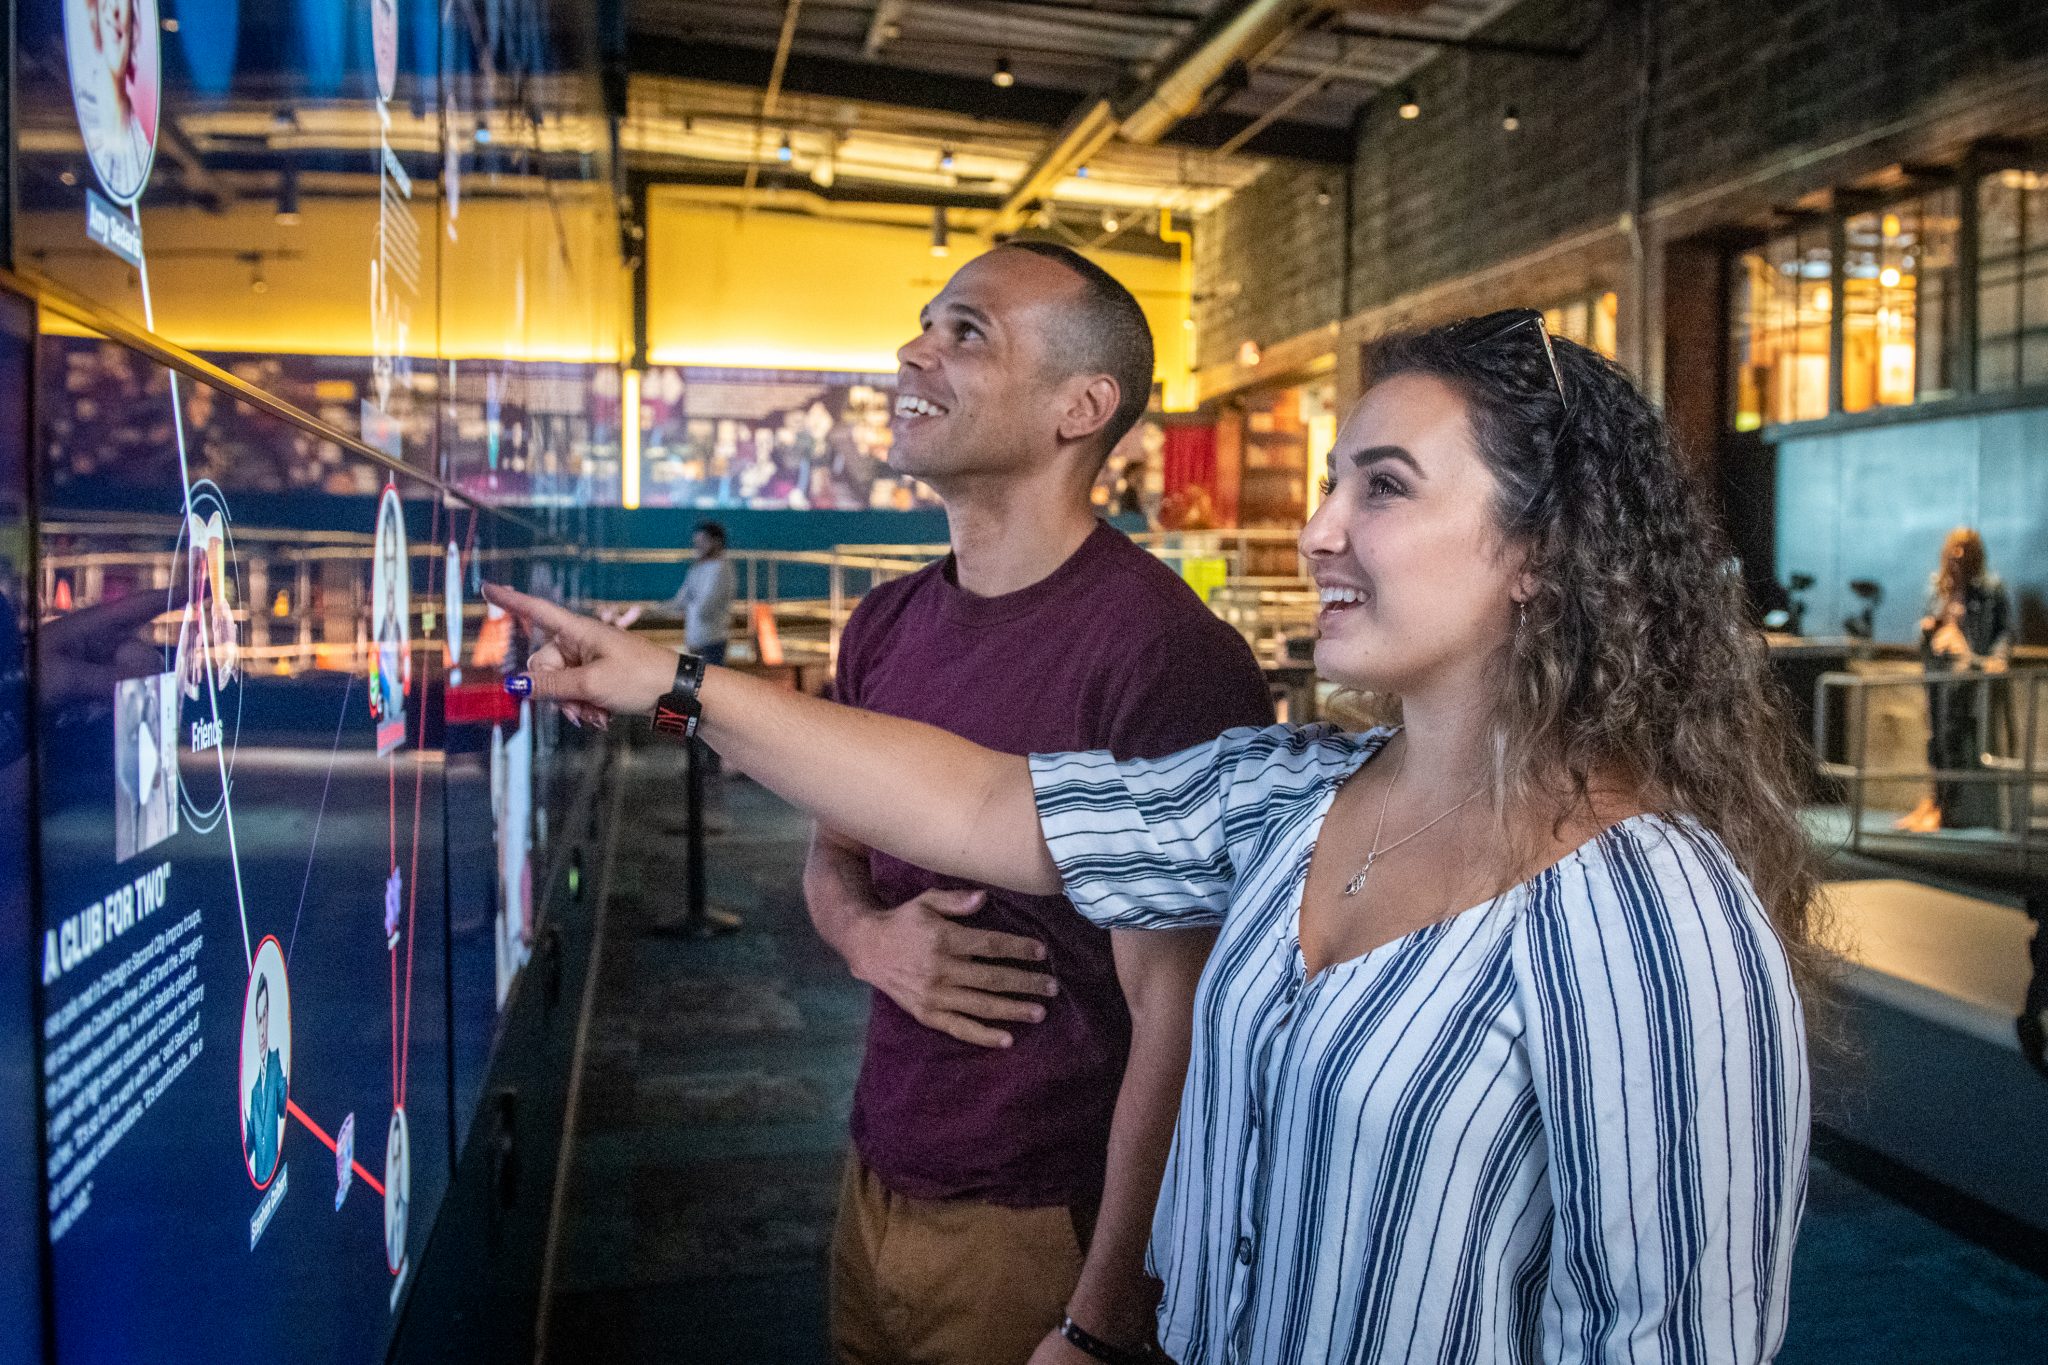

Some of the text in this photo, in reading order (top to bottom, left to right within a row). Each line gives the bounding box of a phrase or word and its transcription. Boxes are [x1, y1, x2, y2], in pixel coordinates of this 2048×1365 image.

[192, 717, 223, 753] Friends
[43, 861, 171, 985] A CLUB FOR TWO"
[101, 959, 131, 995] Chicago's
[131, 940, 153, 972] Second
[154, 934, 164, 954] City
[165, 921, 183, 945] improv
[121, 986, 137, 1012] show
[157, 958, 168, 982] and
[169, 954, 178, 972] the
[178, 935, 202, 964] Strangers
[137, 999, 154, 1027] which
[155, 982, 175, 1011] Sedaris
[175, 966, 192, 997] played
[123, 1034, 146, 1069] student
[147, 1023, 157, 1048] and
[158, 1006, 177, 1036] Colbert
[187, 984, 203, 1008] history
[162, 1036, 174, 1062] said
[174, 1020, 193, 1050] Sedaris
